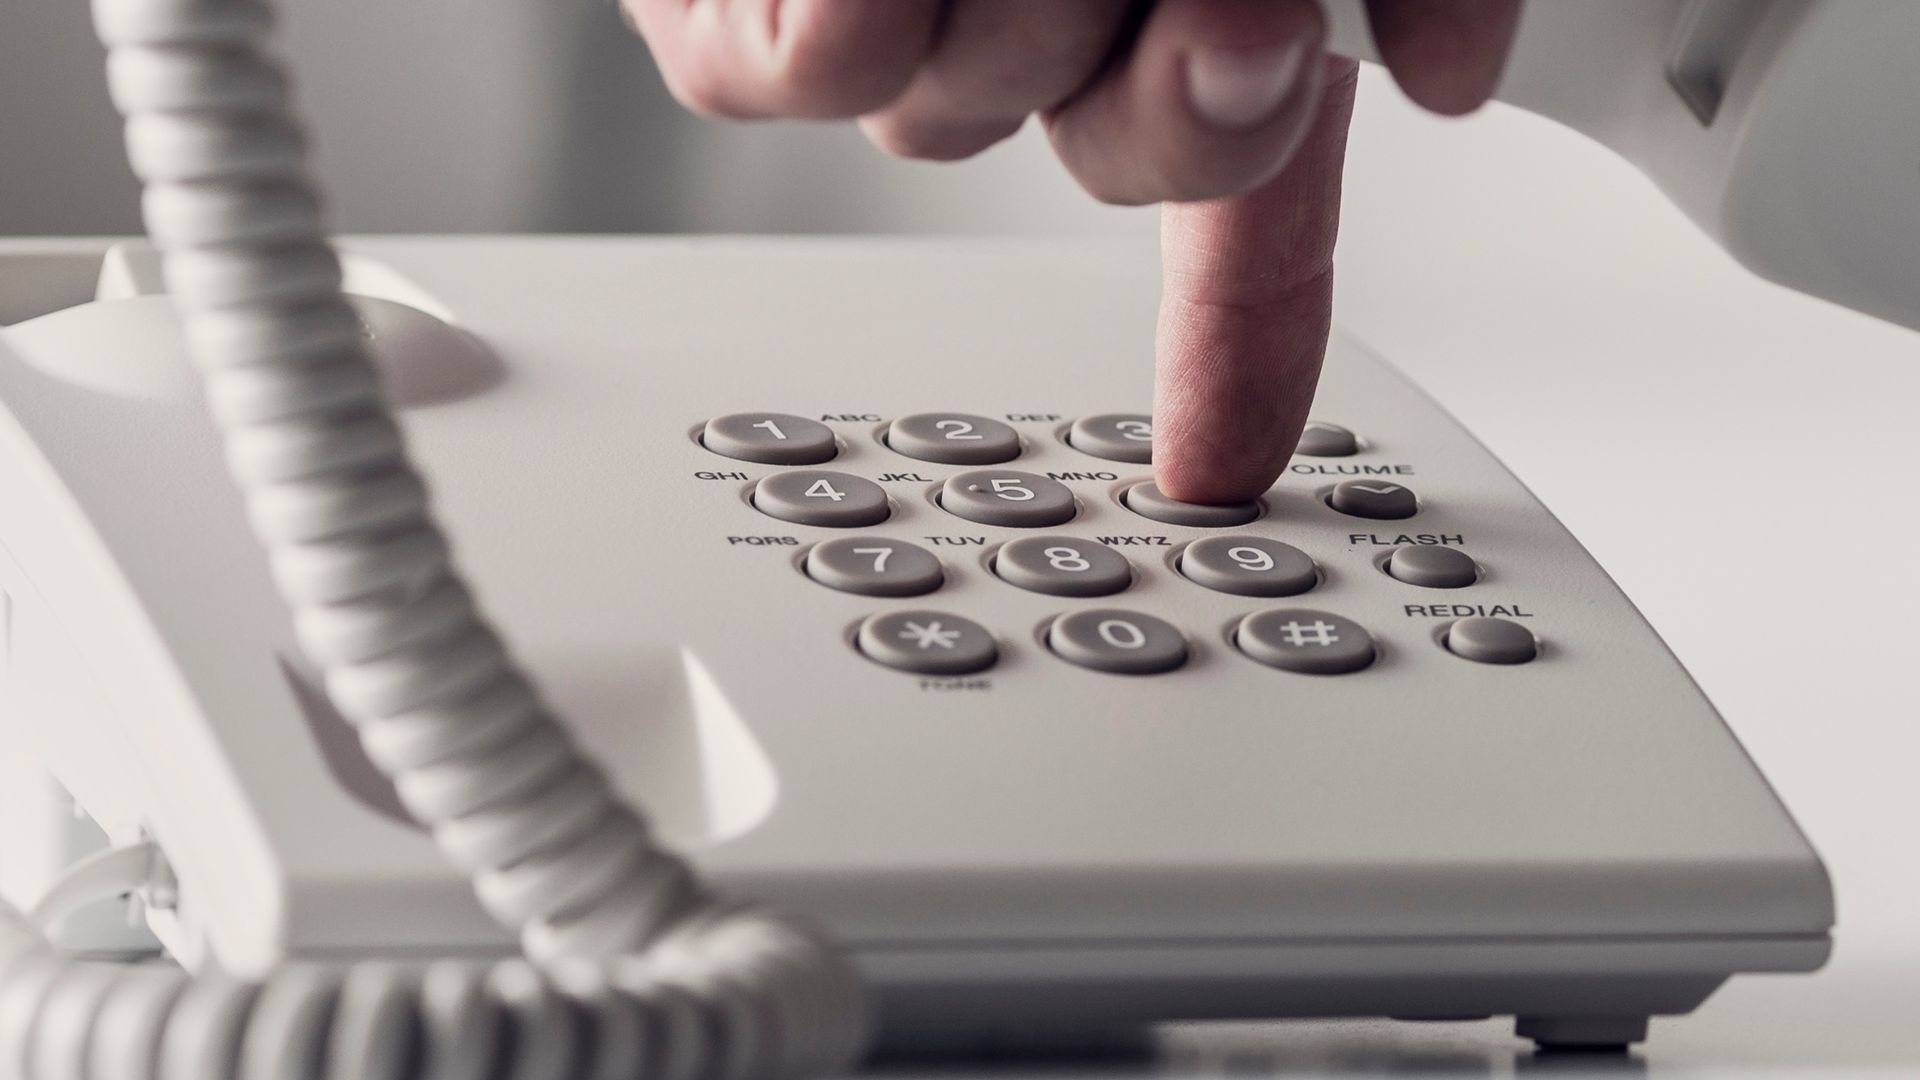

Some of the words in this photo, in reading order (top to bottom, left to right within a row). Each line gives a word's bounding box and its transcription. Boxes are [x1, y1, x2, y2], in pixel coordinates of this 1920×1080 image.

[821, 414, 882, 422] ABC
[1006, 414, 1062, 422] DEF
[752, 420, 787, 439] 1
[936, 420, 982, 440] 2
[1116, 421, 1153, 441] 3
[1291, 464, 1415, 475] OLUME
[694, 472, 748, 481] GHI
[878, 473, 933, 482] JKL
[1046, 472, 1118, 481] MNO
[805, 479, 845, 501] 4
[991, 479, 1034, 501] 5
[727, 536, 800, 546] PQRS
[924, 536, 986, 546] TUV
[1097, 536, 1172, 546] WXYZ
[1349, 534, 1464, 545] FLASH
[853, 547, 893, 572] 7
[1044, 547, 1090, 571] 8
[1228, 547, 1275, 571] 9
[1404, 605, 1533, 617] REDIAL
[1098, 620, 1145, 649] 0
[1280, 620, 1339, 646] #
